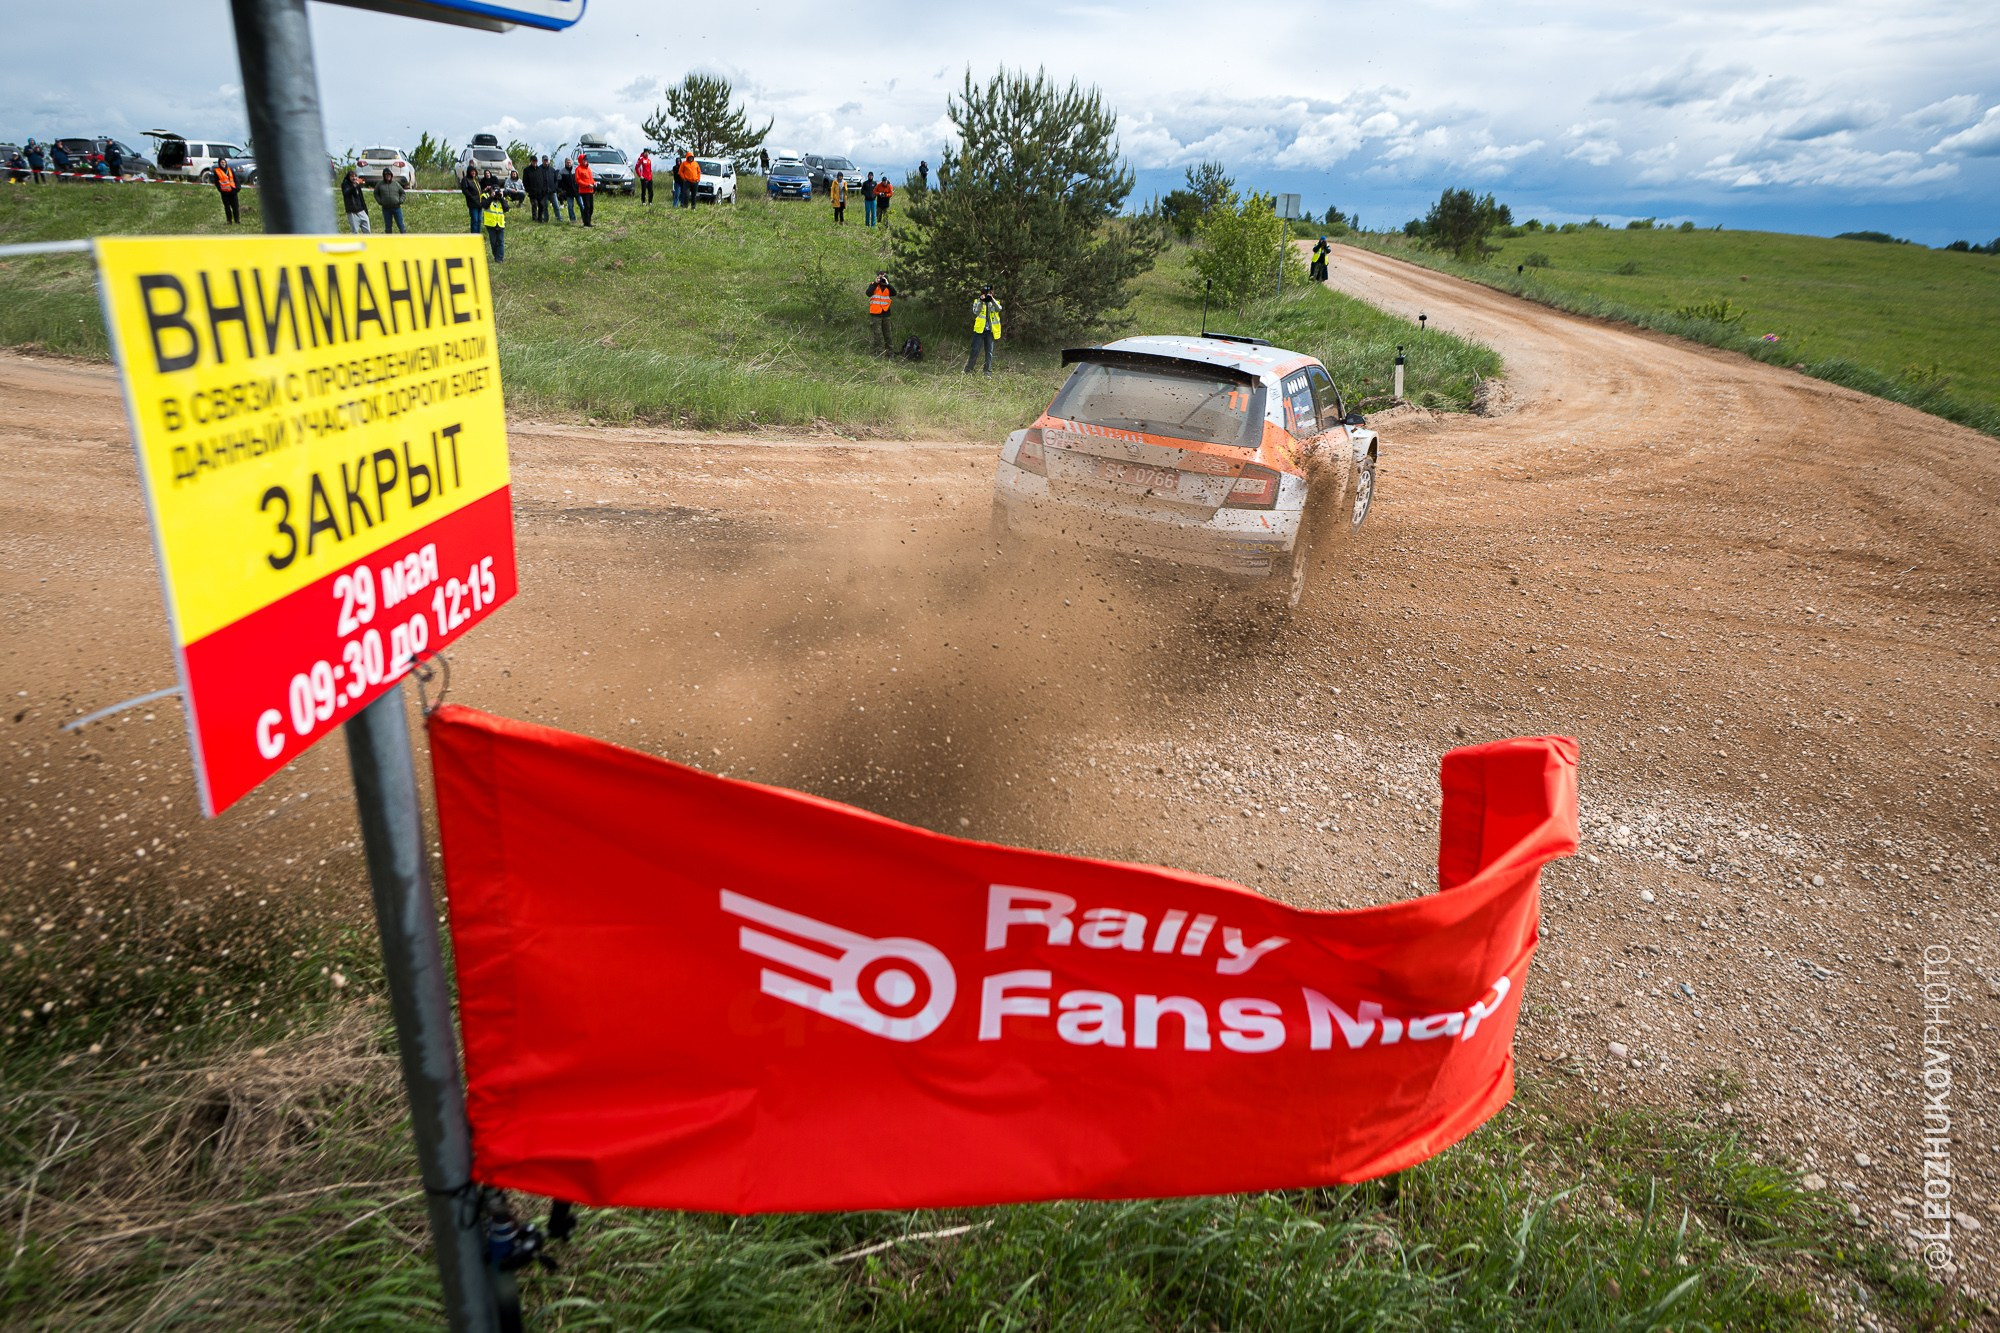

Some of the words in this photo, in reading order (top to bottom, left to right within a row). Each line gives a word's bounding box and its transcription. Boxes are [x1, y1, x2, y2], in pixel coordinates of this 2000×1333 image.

[139, 257, 482, 373] ВНИМАНИЕ!
[161, 397, 184, 432] В
[191, 377, 281, 423] СВЯЗИ
[286, 373, 302, 402] С
[307, 345, 440, 398] ПРОВЕДЕНИЕМ
[444, 336, 486, 366] РАЛЛИ
[172, 412, 289, 488] ДАННЫЙ
[291, 394, 384, 445] УЧАСТОК
[388, 378, 448, 422] ДОРОГИ
[451, 366, 491, 398] БУДЕТ
[1228, 390, 1249, 413] 11
[260, 422, 462, 570] ЗАКРЫТ
[1135, 468, 1175, 489] 0766
[333, 564, 376, 638] 29
[381, 543, 439, 609] мая
[289, 628, 384, 736] 09:30
[382, 612, 429, 685] до
[431, 555, 496, 637] 12:15
[985, 883, 1291, 976] Rally
[978, 968, 1287, 1054] Fans
[1301, 975, 1512, 1051] Map
